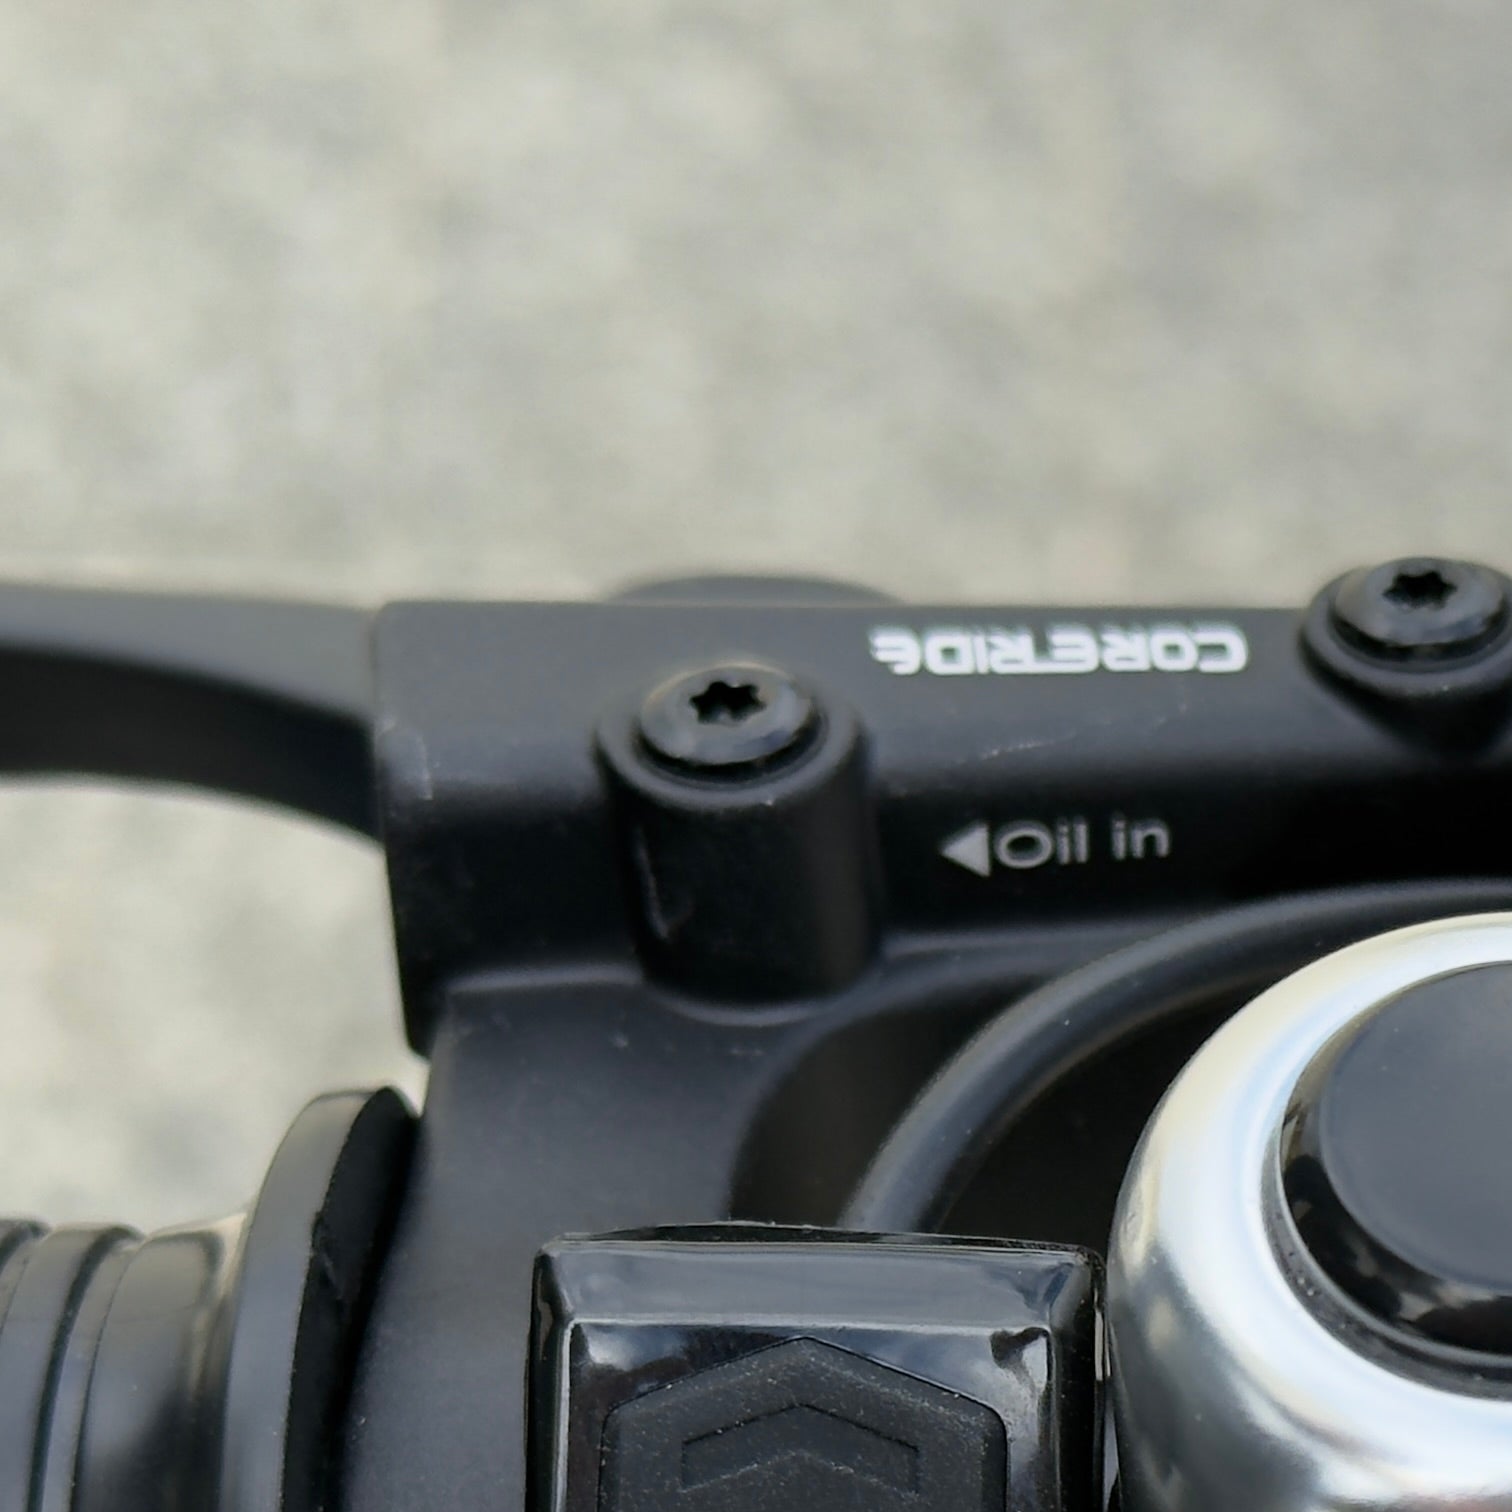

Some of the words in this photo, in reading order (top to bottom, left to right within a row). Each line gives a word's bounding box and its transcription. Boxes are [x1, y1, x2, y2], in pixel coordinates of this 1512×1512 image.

[869, 624, 1249, 675] CORERIDE
[994, 816, 1089, 869] Oil
[1112, 813, 1171, 861] in
